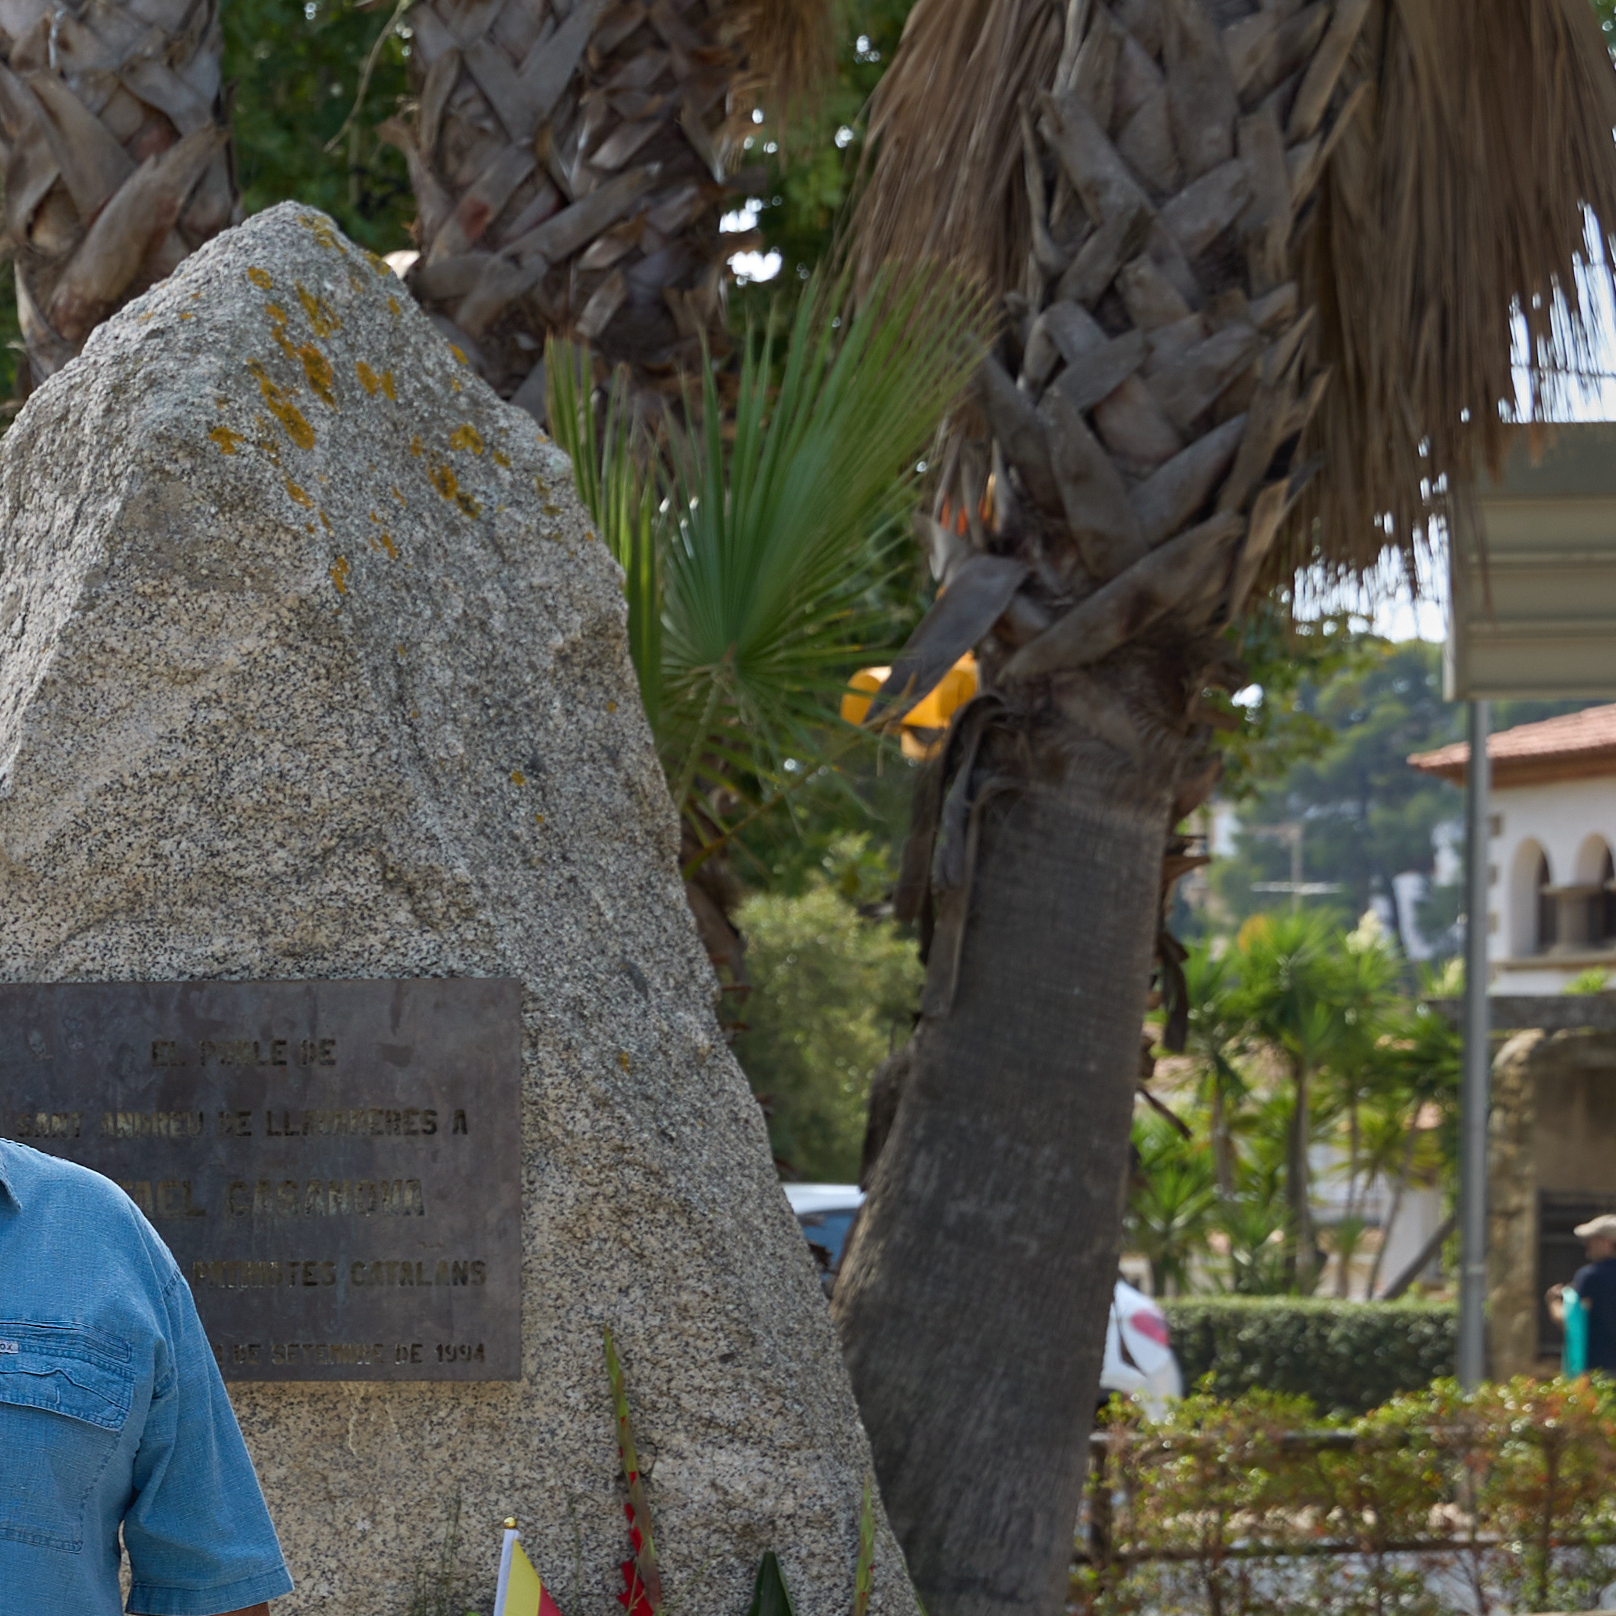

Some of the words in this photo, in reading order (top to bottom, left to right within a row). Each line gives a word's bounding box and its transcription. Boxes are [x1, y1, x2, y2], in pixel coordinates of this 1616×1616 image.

[151, 1039, 187, 1067] EL
[300, 1038, 337, 1066] DE
[16, 1111, 83, 1138] SANT
[99, 1110, 204, 1138] ANDREU
[217, 1110, 253, 1137] DE
[452, 1108, 469, 1135] A
[227, 1178, 425, 1217] CASANOVA
[350, 1259, 487, 1287] CATALANS
[233, 1342, 262, 1365] DE
[395, 1342, 424, 1365] DE
[435, 1342, 486, 1365] 1994
